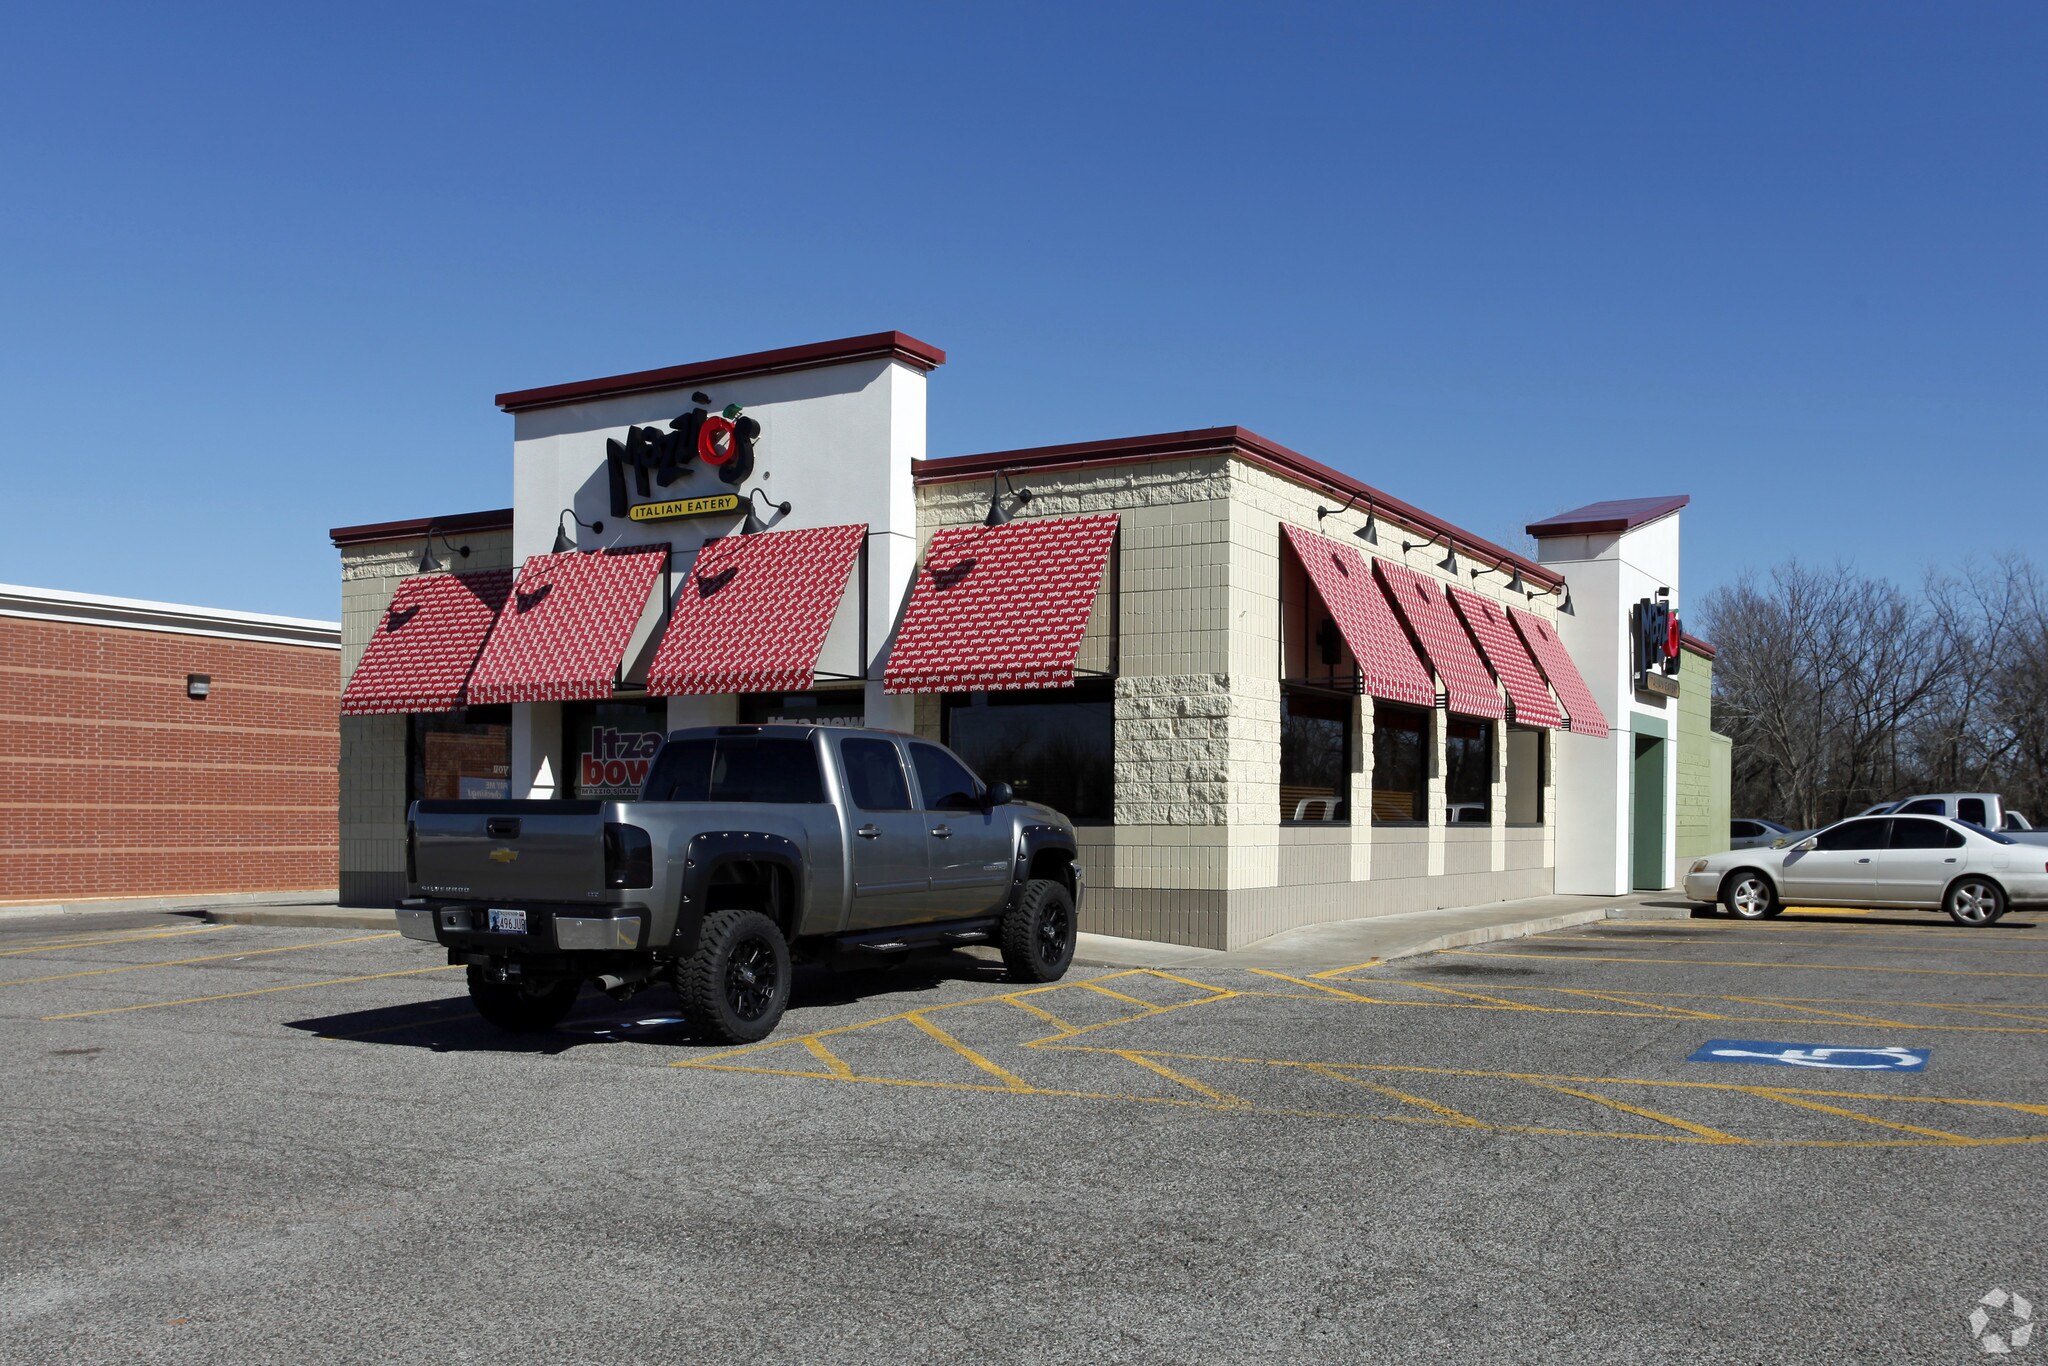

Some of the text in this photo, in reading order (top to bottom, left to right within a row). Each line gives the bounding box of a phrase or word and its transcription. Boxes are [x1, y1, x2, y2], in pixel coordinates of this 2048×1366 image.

[635, 498, 732, 517] ITALIAN EATERY
[592, 726, 663, 760] Itza
